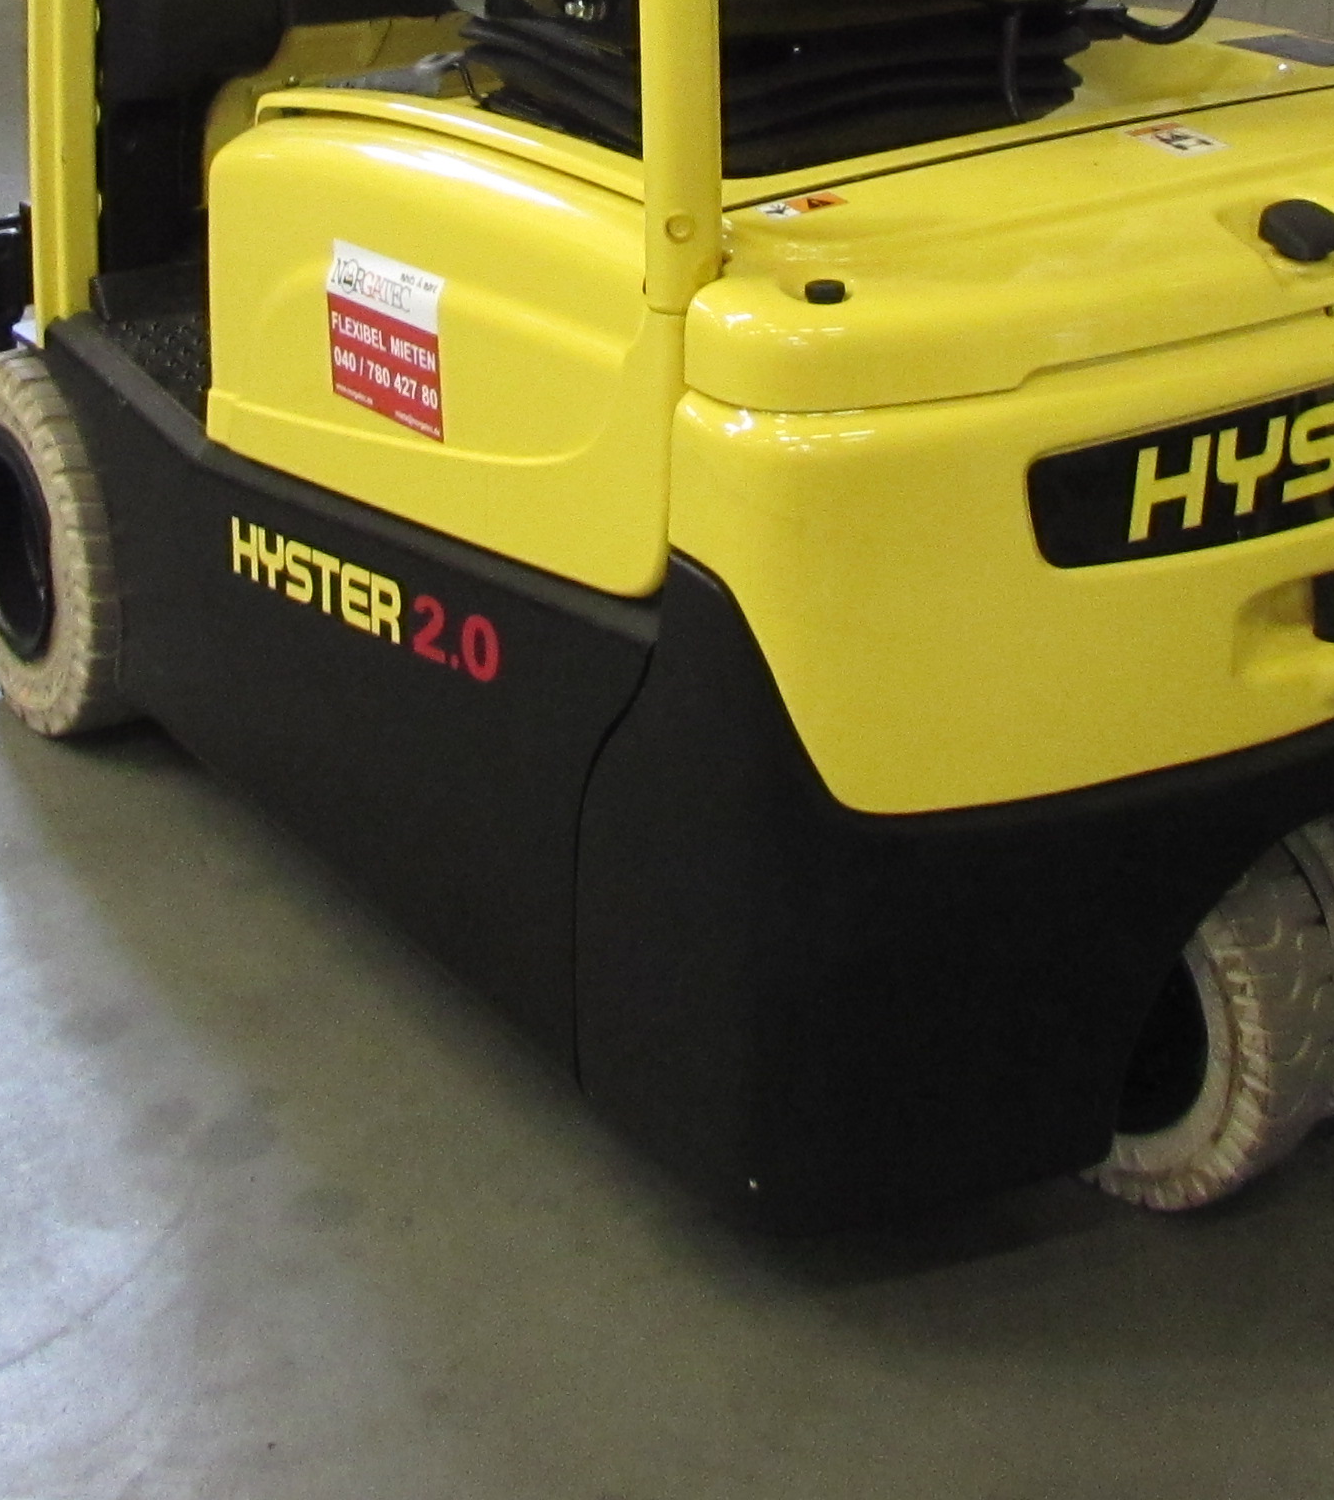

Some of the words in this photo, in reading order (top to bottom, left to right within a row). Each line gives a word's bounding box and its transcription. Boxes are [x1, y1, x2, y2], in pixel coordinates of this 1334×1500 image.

[331, 310, 387, 352] FLEXIBEL
[390, 335, 436, 373] MIETEN
[334, 345, 357, 372] 040
[366, 360, 391, 388] 780
[394, 372, 417, 400] 427
[421, 384, 438, 410] 80
[231, 515, 402, 645] HYSTER
[412, 594, 500, 683] 2.0
